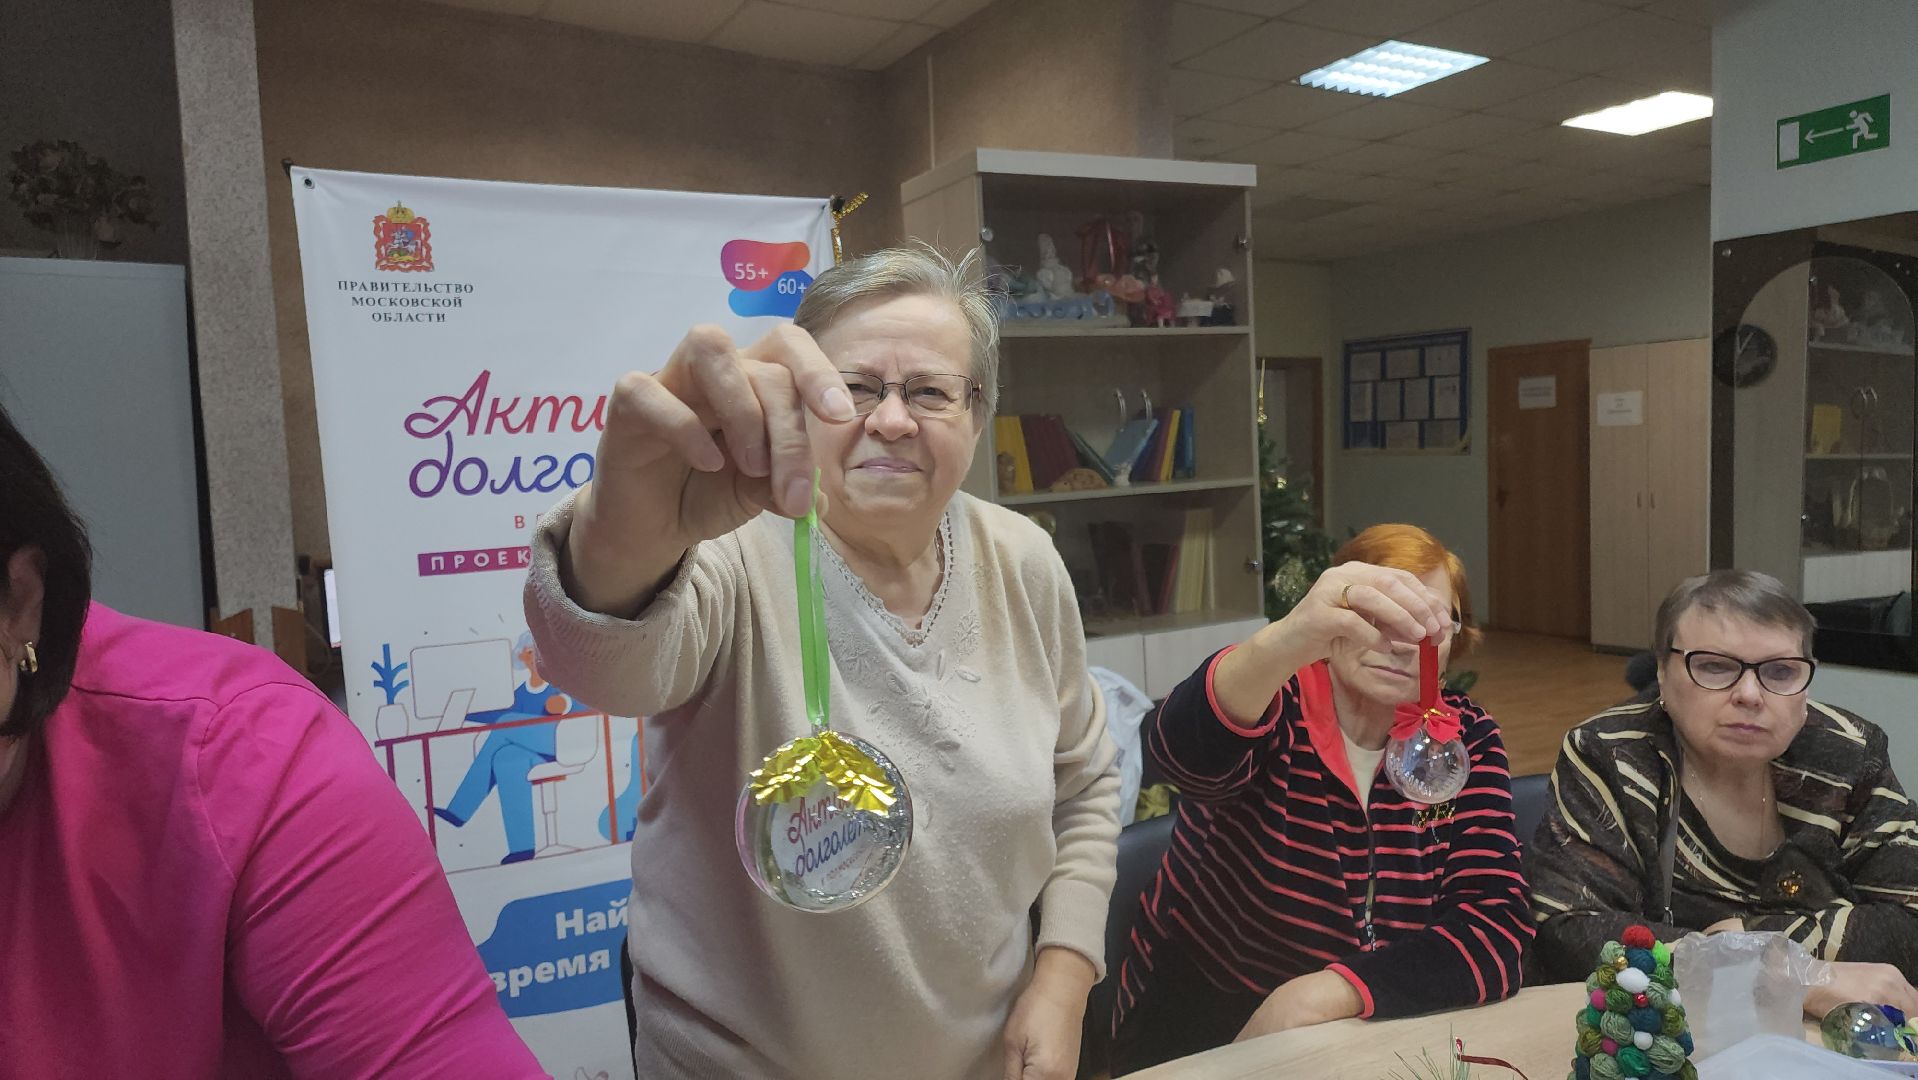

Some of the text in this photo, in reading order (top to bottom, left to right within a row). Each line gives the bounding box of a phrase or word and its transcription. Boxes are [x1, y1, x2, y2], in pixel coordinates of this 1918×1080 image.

[734, 263, 769, 280] 55+
[338, 280, 474, 294] ПРАВИТЕЛЬСТВО
[777, 278, 807, 295] 60+
[351, 296, 463, 308] МОСКОВСКОЙ
[371, 312, 446, 323] ОБЛАСТИ
[409, 430, 595, 498] долго
[488, 948, 611, 999] время
